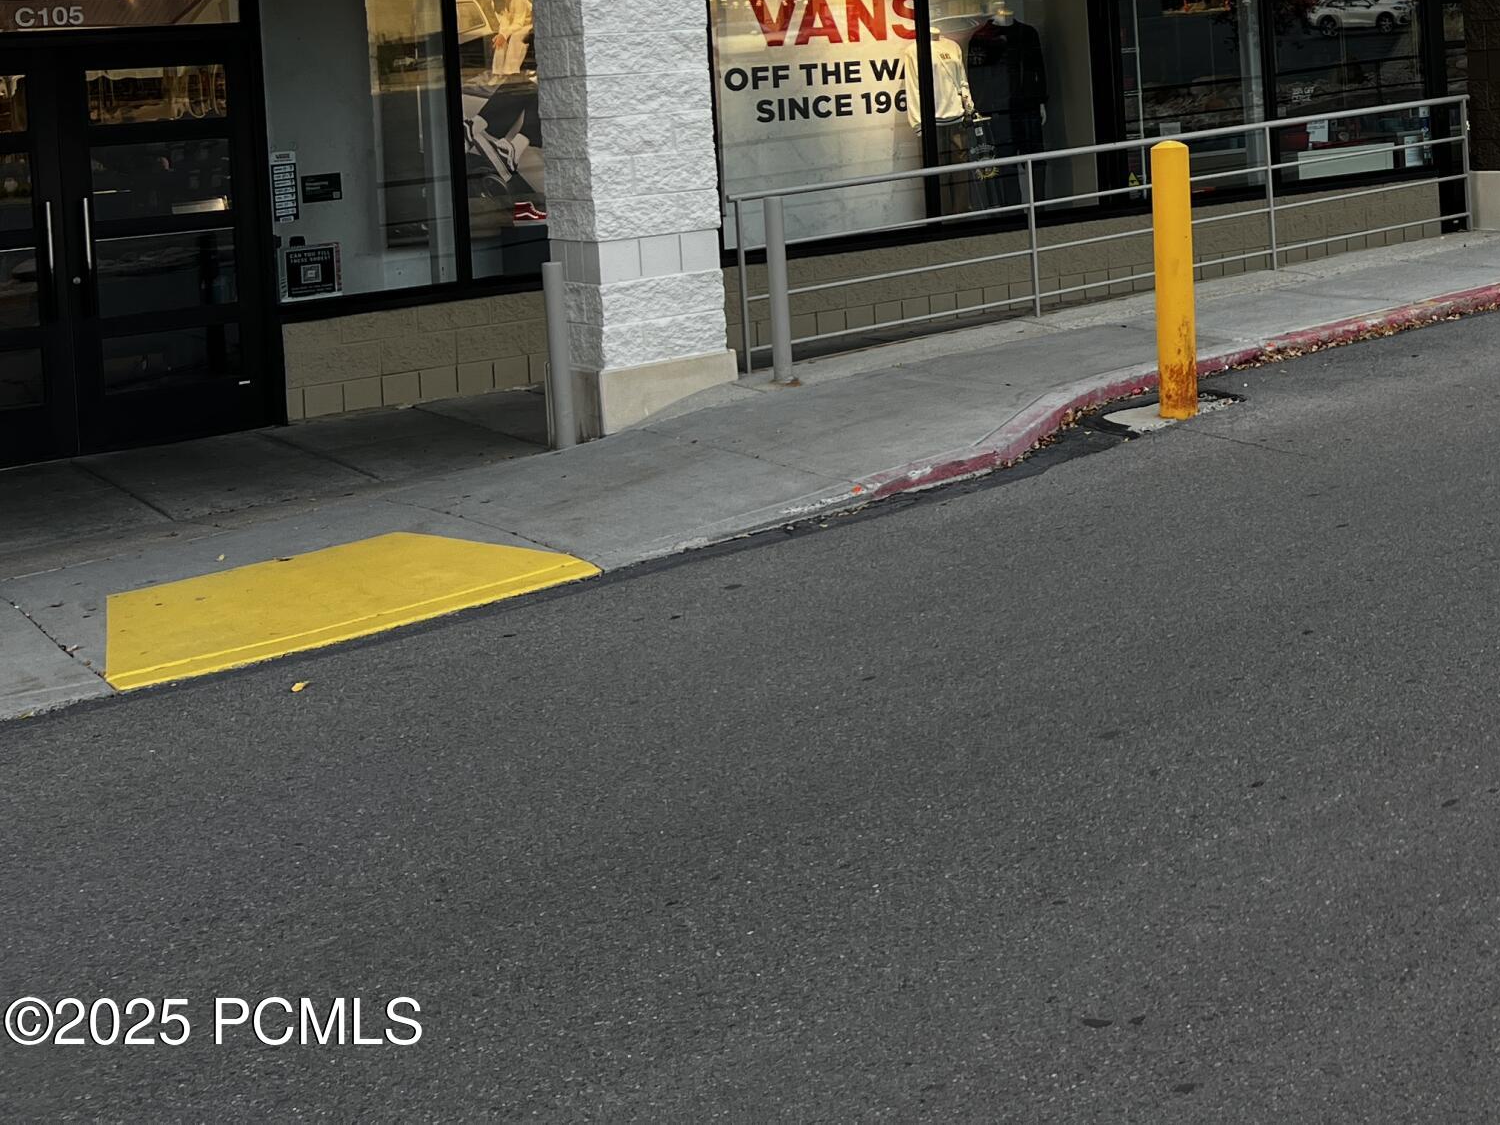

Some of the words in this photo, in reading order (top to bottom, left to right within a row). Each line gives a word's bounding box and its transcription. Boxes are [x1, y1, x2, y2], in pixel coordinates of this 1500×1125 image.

[15, 6, 84, 27] C105
[724, 65, 790, 92] OFF
[799, 60, 862, 86] THE
[869, 58, 906, 82] W
[756, 94, 853, 123] SINCE
